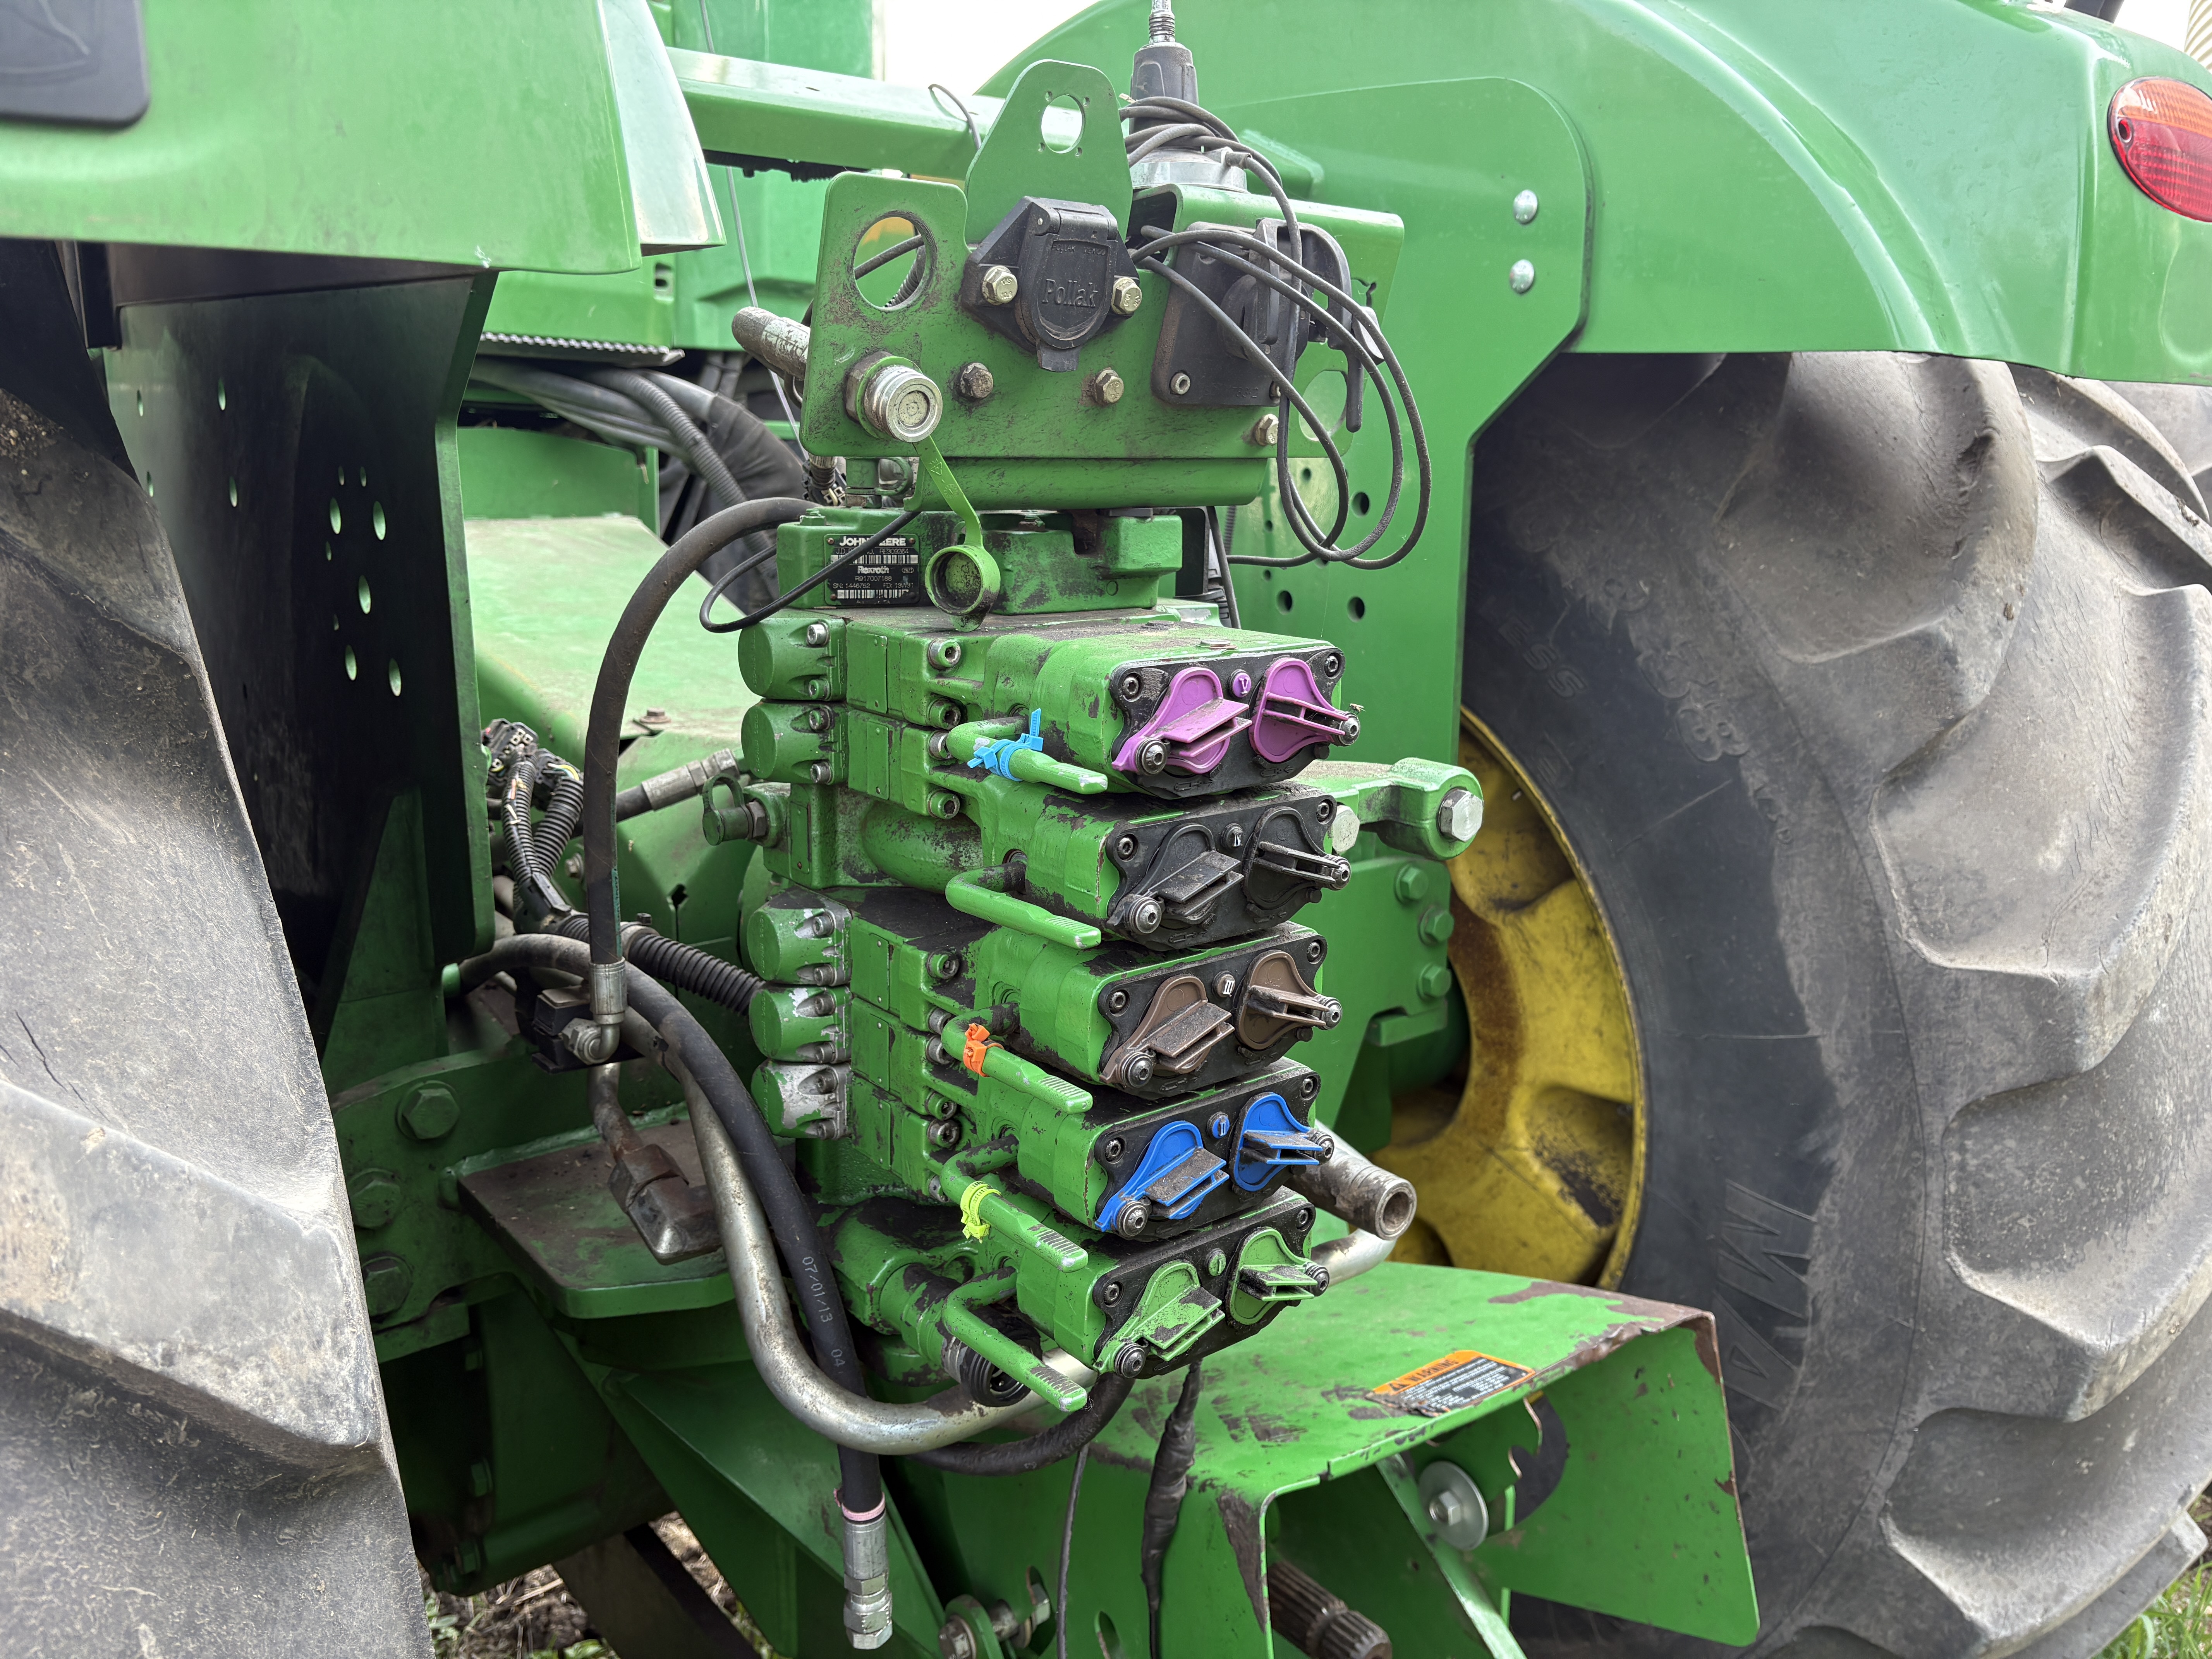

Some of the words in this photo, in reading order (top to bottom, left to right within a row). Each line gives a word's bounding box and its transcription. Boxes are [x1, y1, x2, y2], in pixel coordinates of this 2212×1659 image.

[1042, 278, 1098, 308] Pollak
[857, 566, 890, 574] Rexroth
[1239, 676, 1250, 695] V
[1222, 979, 1235, 995] III
[1219, 1121, 1227, 1137] II
[802, 1256, 833, 1322] 07/01/13
